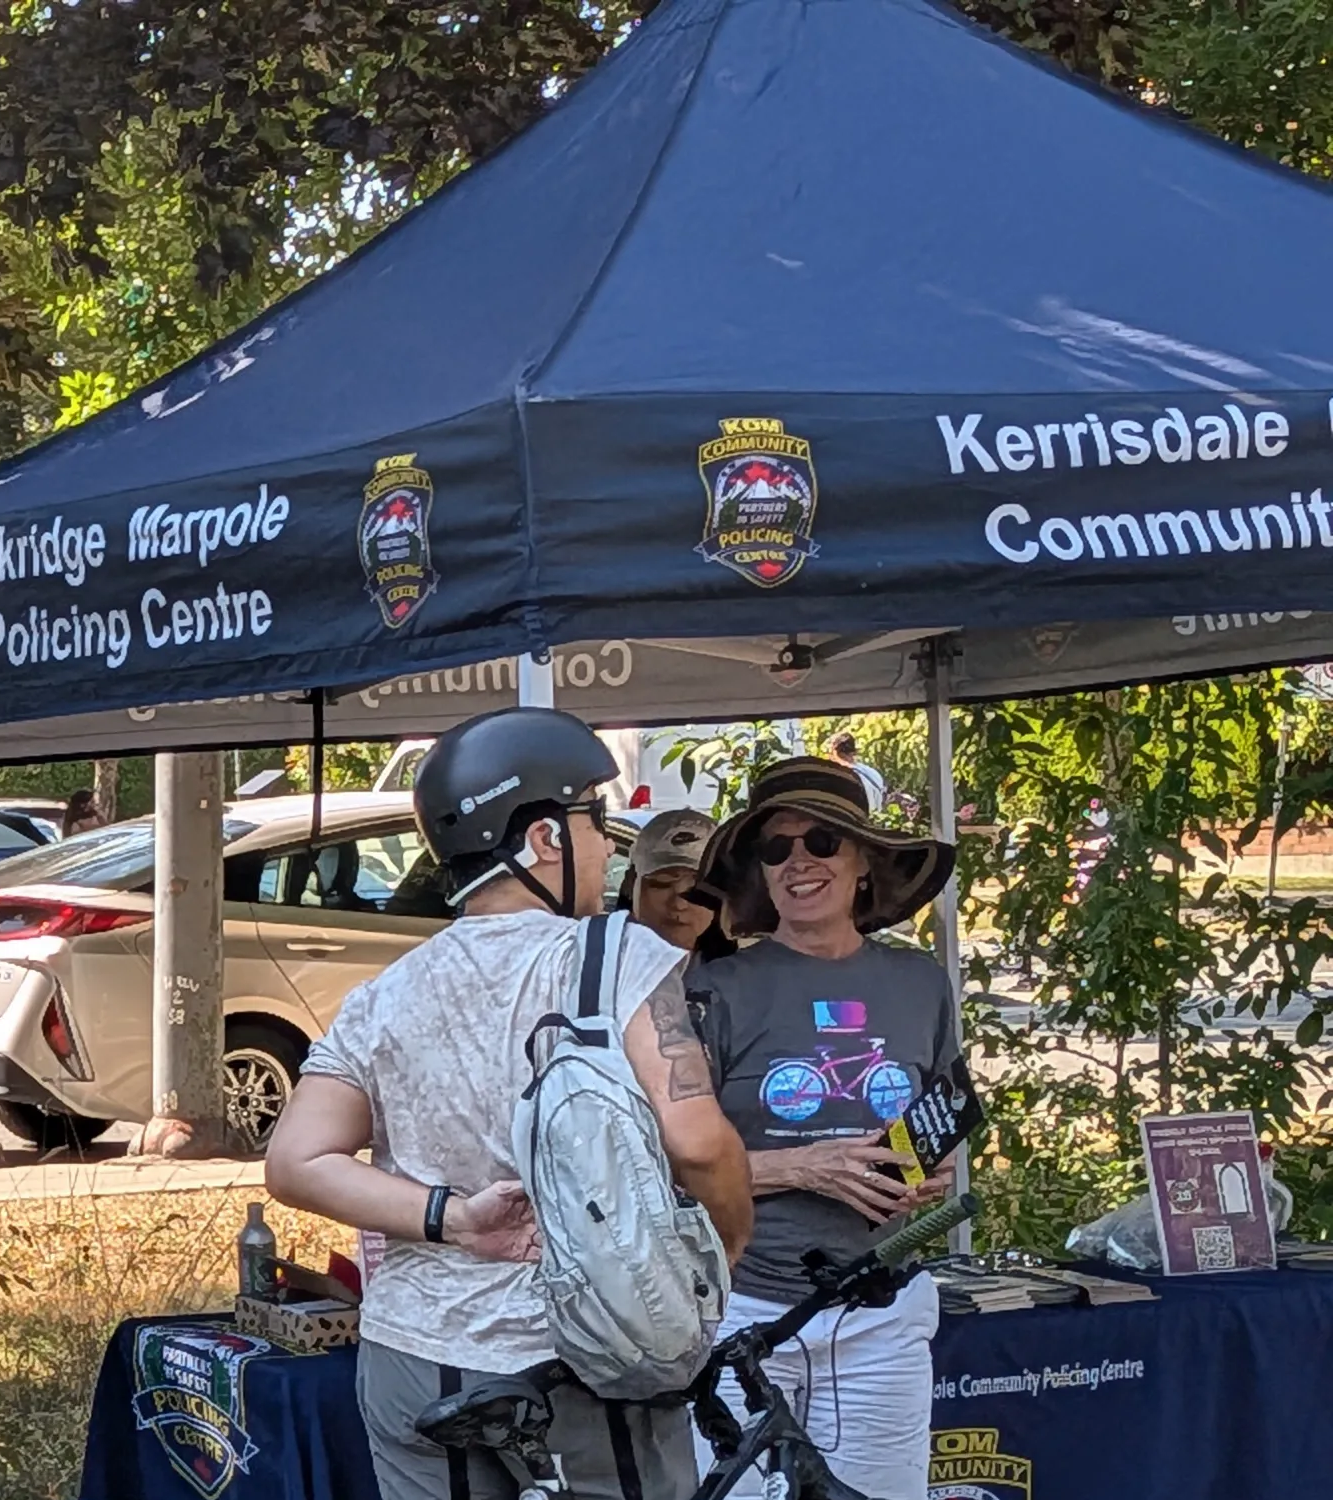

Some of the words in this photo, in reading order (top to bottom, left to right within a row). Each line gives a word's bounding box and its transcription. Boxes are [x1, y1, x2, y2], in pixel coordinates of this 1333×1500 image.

[702, 436, 807, 460] COMMUNITY
[935, 404, 1290, 474] Kerrisdale
[128, 483, 290, 568] Marpole
[719, 528, 794, 549] POLICING
[984, 487, 1333, 563] Communit
[141, 582, 273, 649] Centre
[959, 1368, 1040, 1397] Community
[1042, 1362, 1099, 1391] Policing
[1100, 1359, 1145, 1383] Centre
[152, 1391, 230, 1437] POLICING
[931, 1432, 995, 1454] OM
[930, 1457, 1029, 1482] MUNITY
